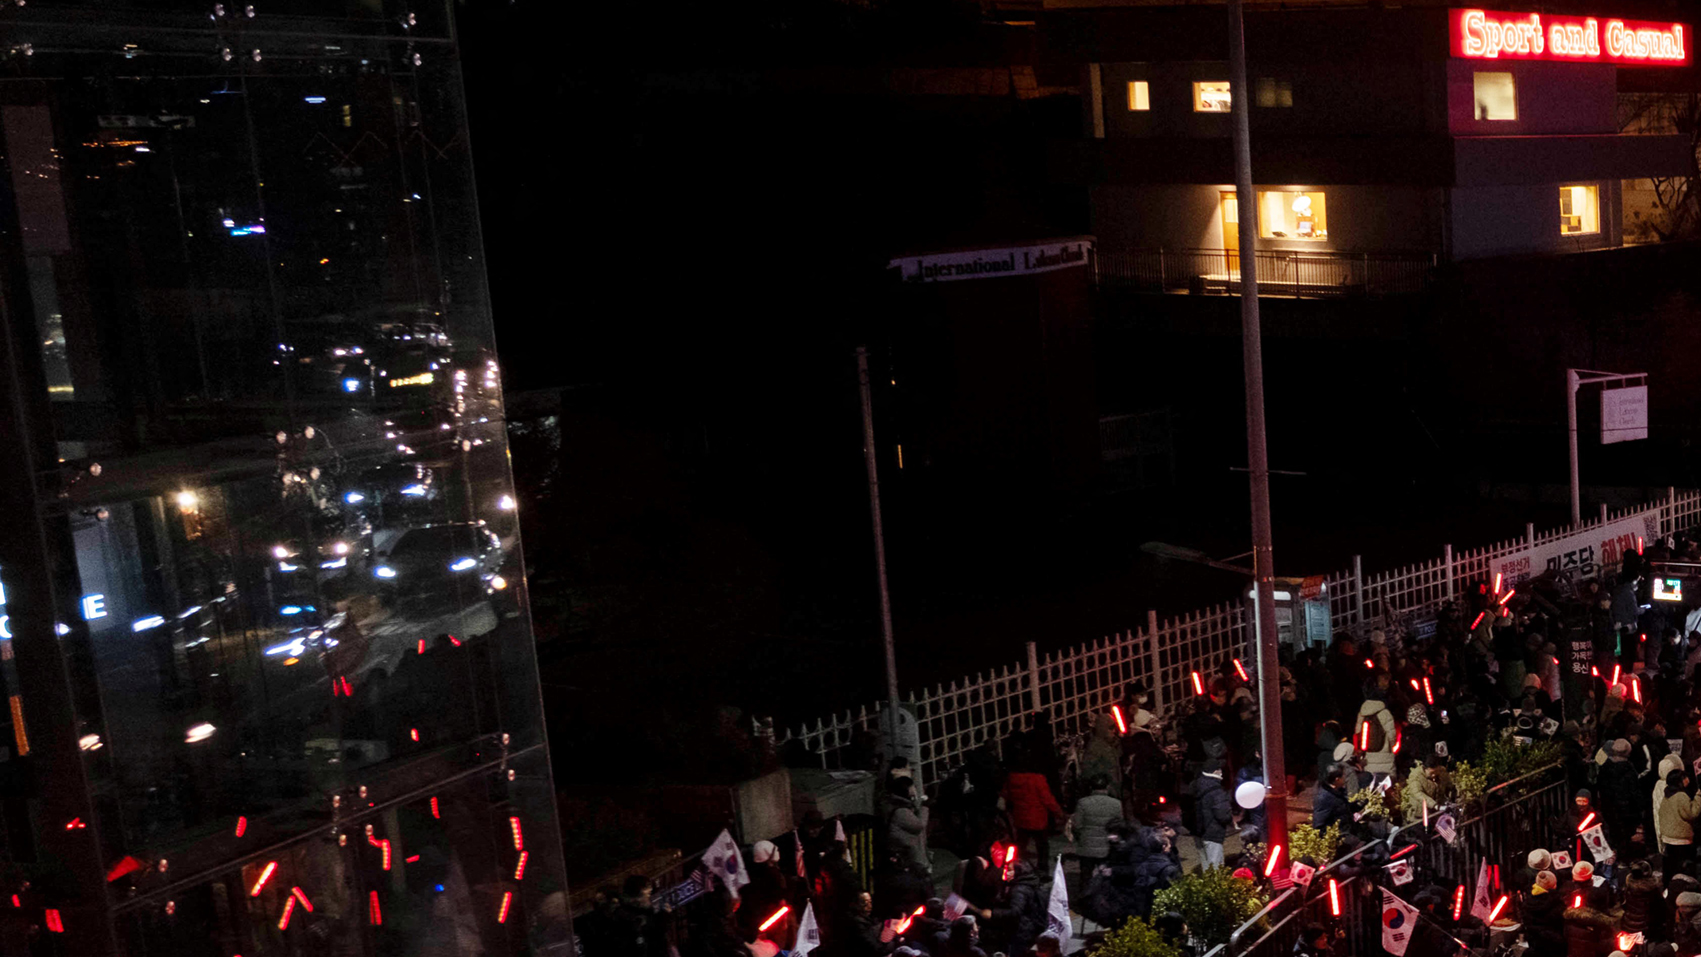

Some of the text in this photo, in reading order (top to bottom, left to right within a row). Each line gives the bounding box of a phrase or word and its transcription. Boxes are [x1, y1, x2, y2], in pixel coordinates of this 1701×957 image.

[1463, 11, 1685, 59] Sport and Casual
[918, 252, 1015, 278] International
